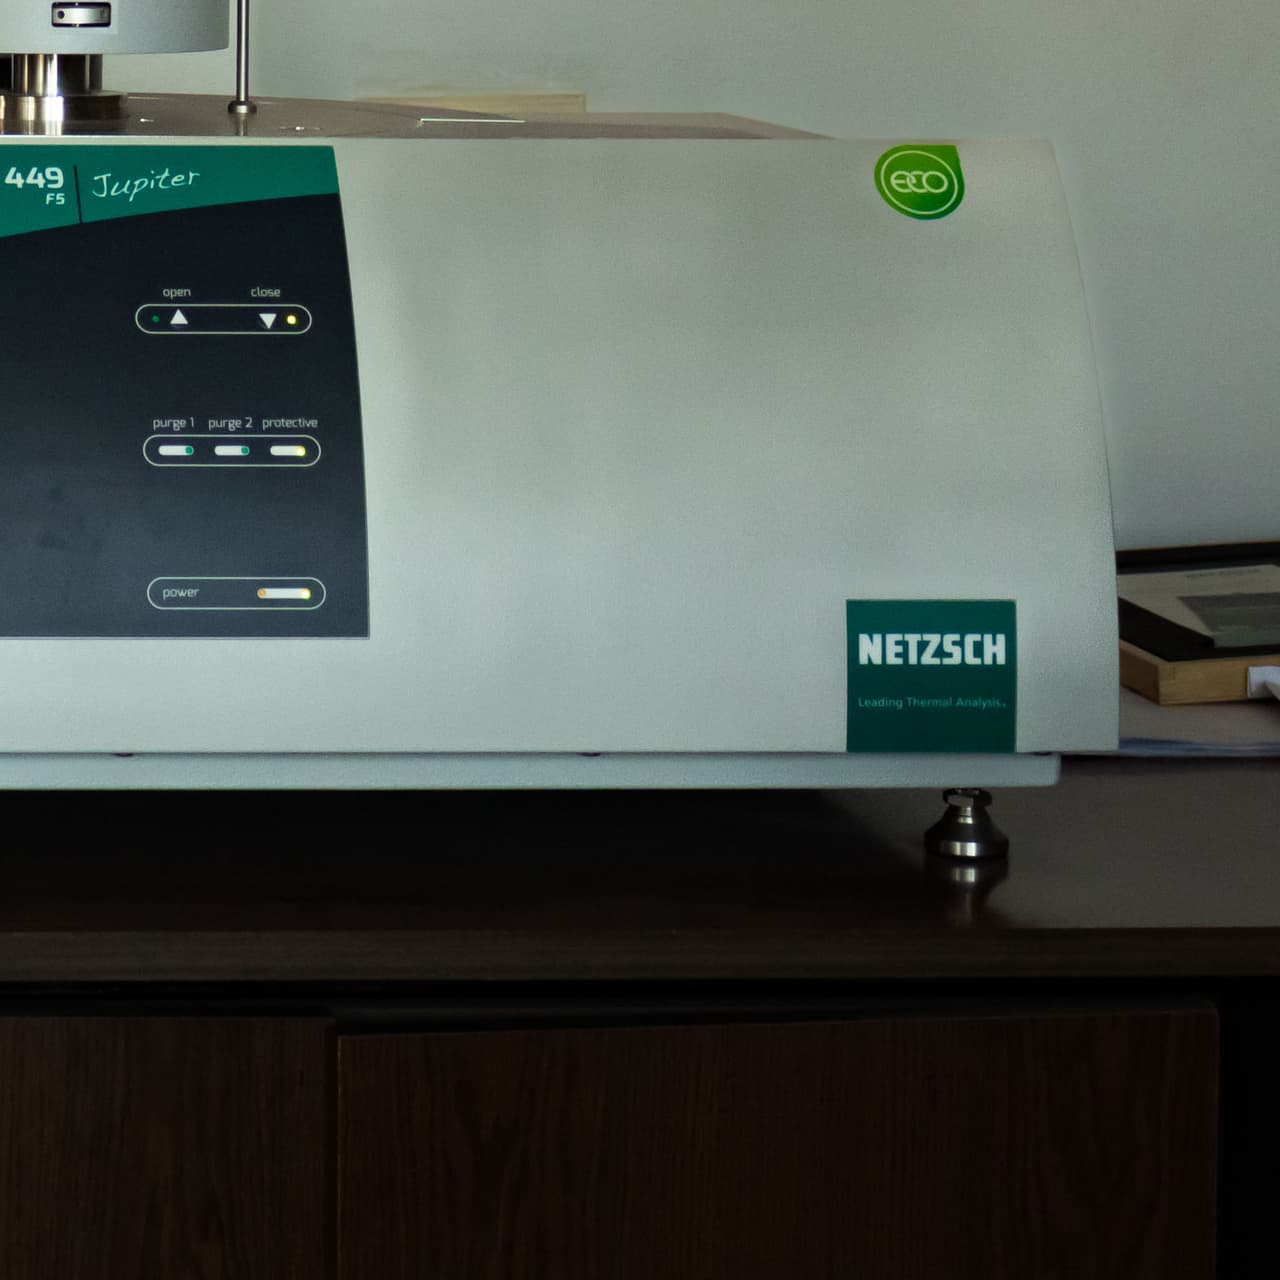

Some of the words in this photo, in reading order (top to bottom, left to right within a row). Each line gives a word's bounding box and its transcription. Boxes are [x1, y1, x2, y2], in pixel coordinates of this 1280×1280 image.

[4, 167, 64, 188] 449
[92, 168, 200, 202] Jupiter
[46, 193, 65, 205] F5
[162, 287, 191, 299] open
[250, 286, 281, 297] close
[153, 418, 186, 430] purge
[190, 417, 195, 428] 1
[208, 418, 242, 431] purge
[245, 417, 253, 428] 2
[262, 418, 319, 430] protective
[163, 587, 200, 600] power
[858, 633, 1006, 665] NETZSCH
[858, 697, 903, 709] Leading
[907, 697, 952, 707] Thermal
[955, 697, 1006, 709] Analysis.
